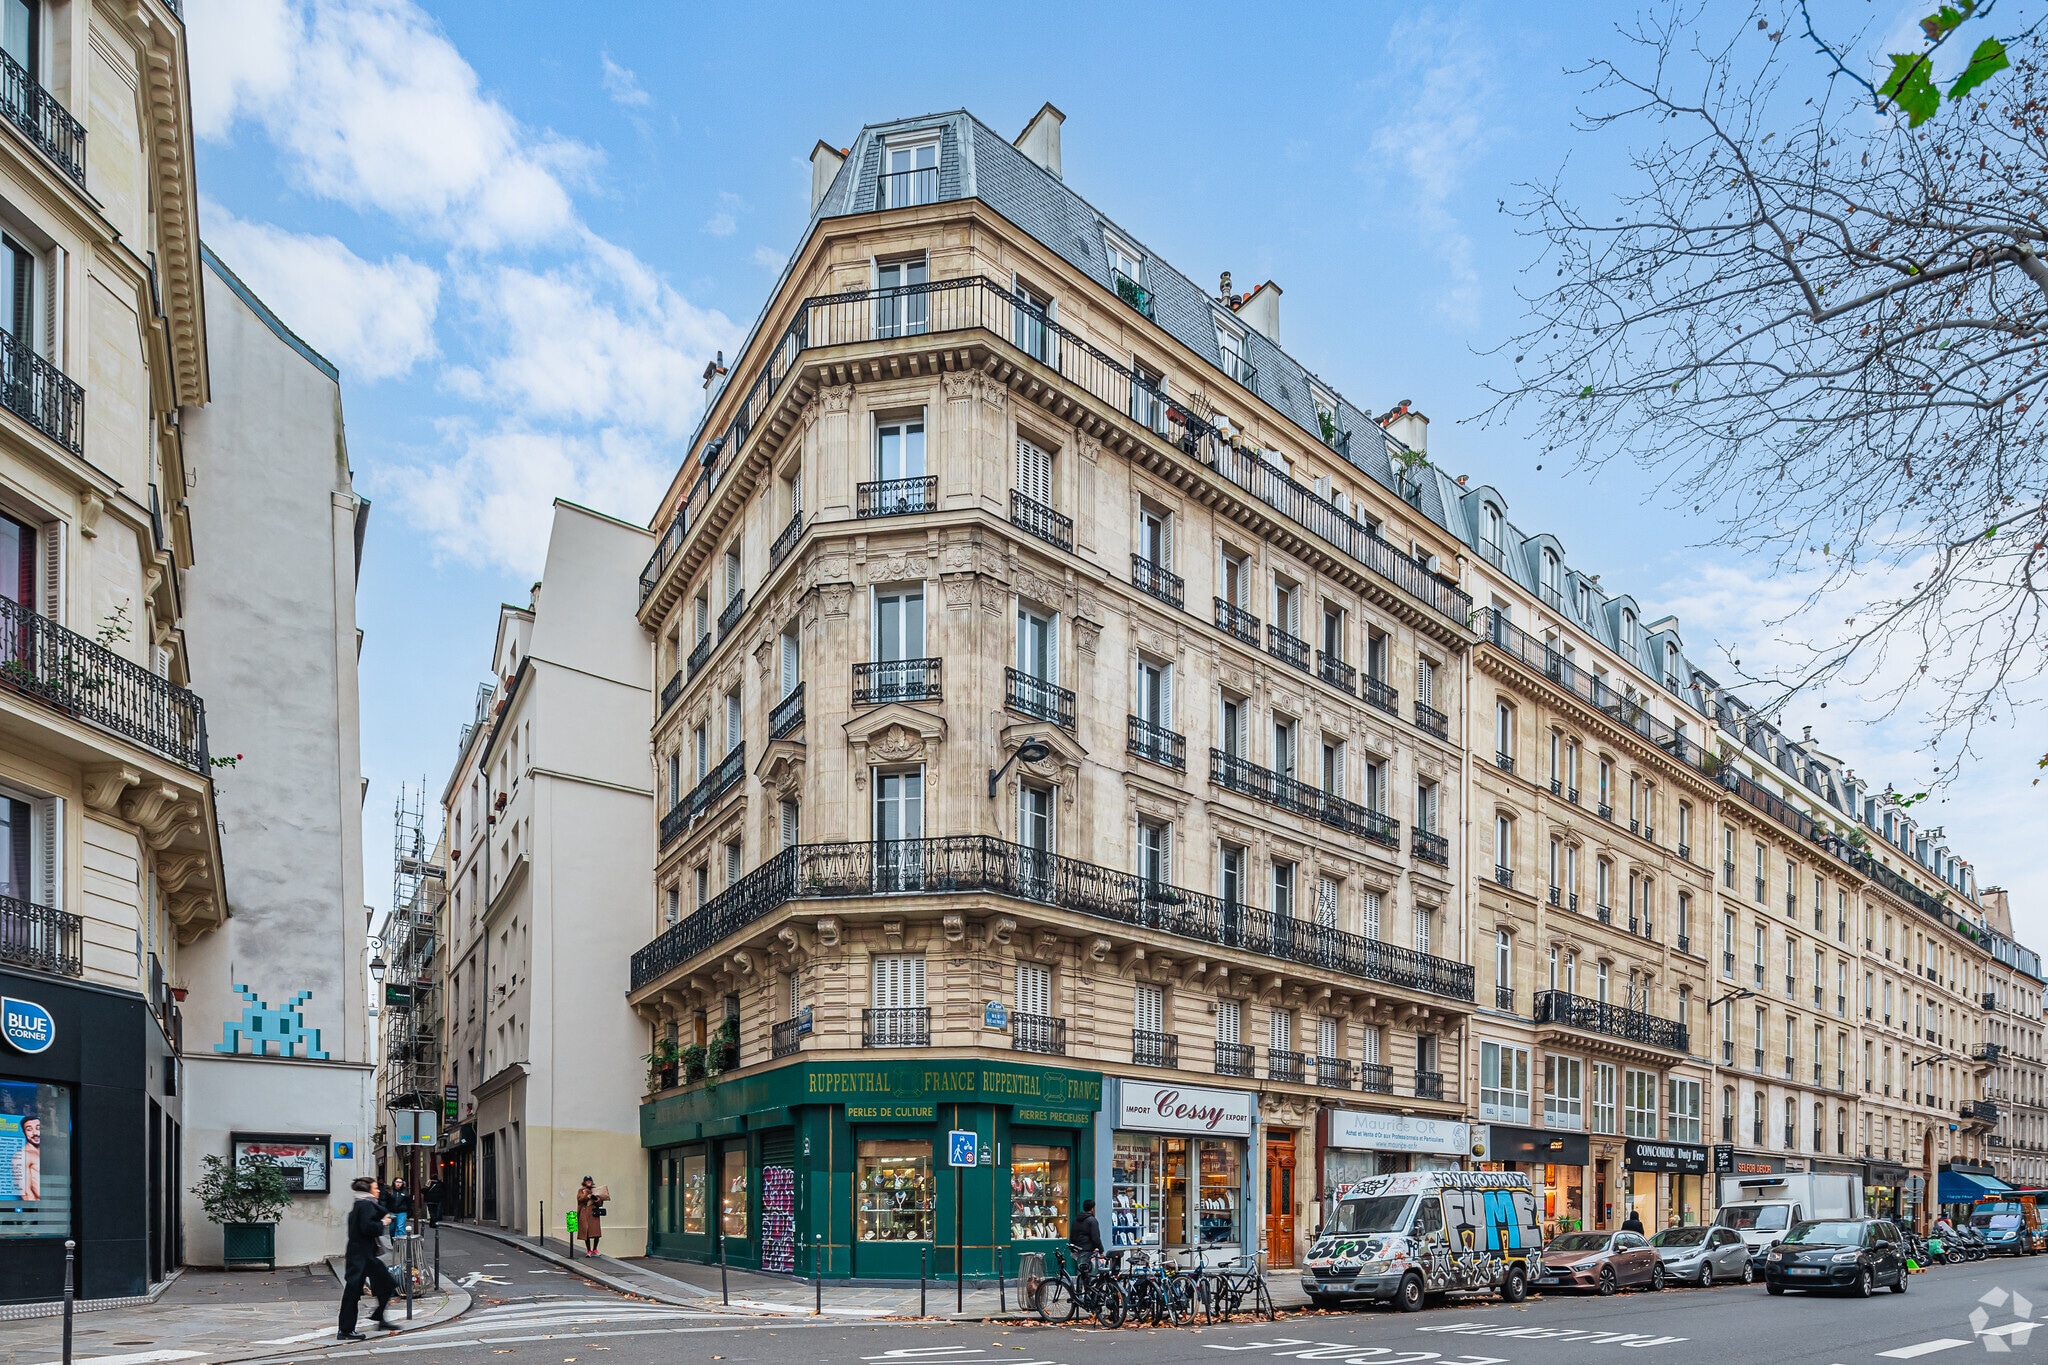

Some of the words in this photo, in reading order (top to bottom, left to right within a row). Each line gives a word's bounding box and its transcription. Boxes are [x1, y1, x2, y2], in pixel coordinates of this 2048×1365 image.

[9, 1012, 47, 1032] BLUE
[9, 1028, 46, 1041] CORNER
[809, 1072, 891, 1092] RUPPENTHAL
[924, 1071, 975, 1091] FRANCE
[983, 1071, 1041, 1096] RUPPENTHAL
[1067, 1079, 1100, 1101] FRANCE
[848, 1107, 877, 1117] PERLES
[880, 1107, 892, 1117] DE
[895, 1107, 933, 1117] CULTURE
[1019, 1109, 1048, 1121] PIERRES
[1050, 1111, 1089, 1124] PRECIEUSES
[1126, 1105, 1150, 1114] IMPORT
[1153, 1089, 1225, 1130] Cessy
[1225, 1114, 1248, 1122] EXPORT
[1354, 1114, 1410, 1132] Maurice
[1416, 1120, 1436, 1134] OR
[1636, 1144, 1675, 1159] CONCORDE
[1678, 1148, 1692, 1162] Duty
[1692, 1150, 1705, 1161] Free
[1737, 1162, 1755, 1173] SELFOR
